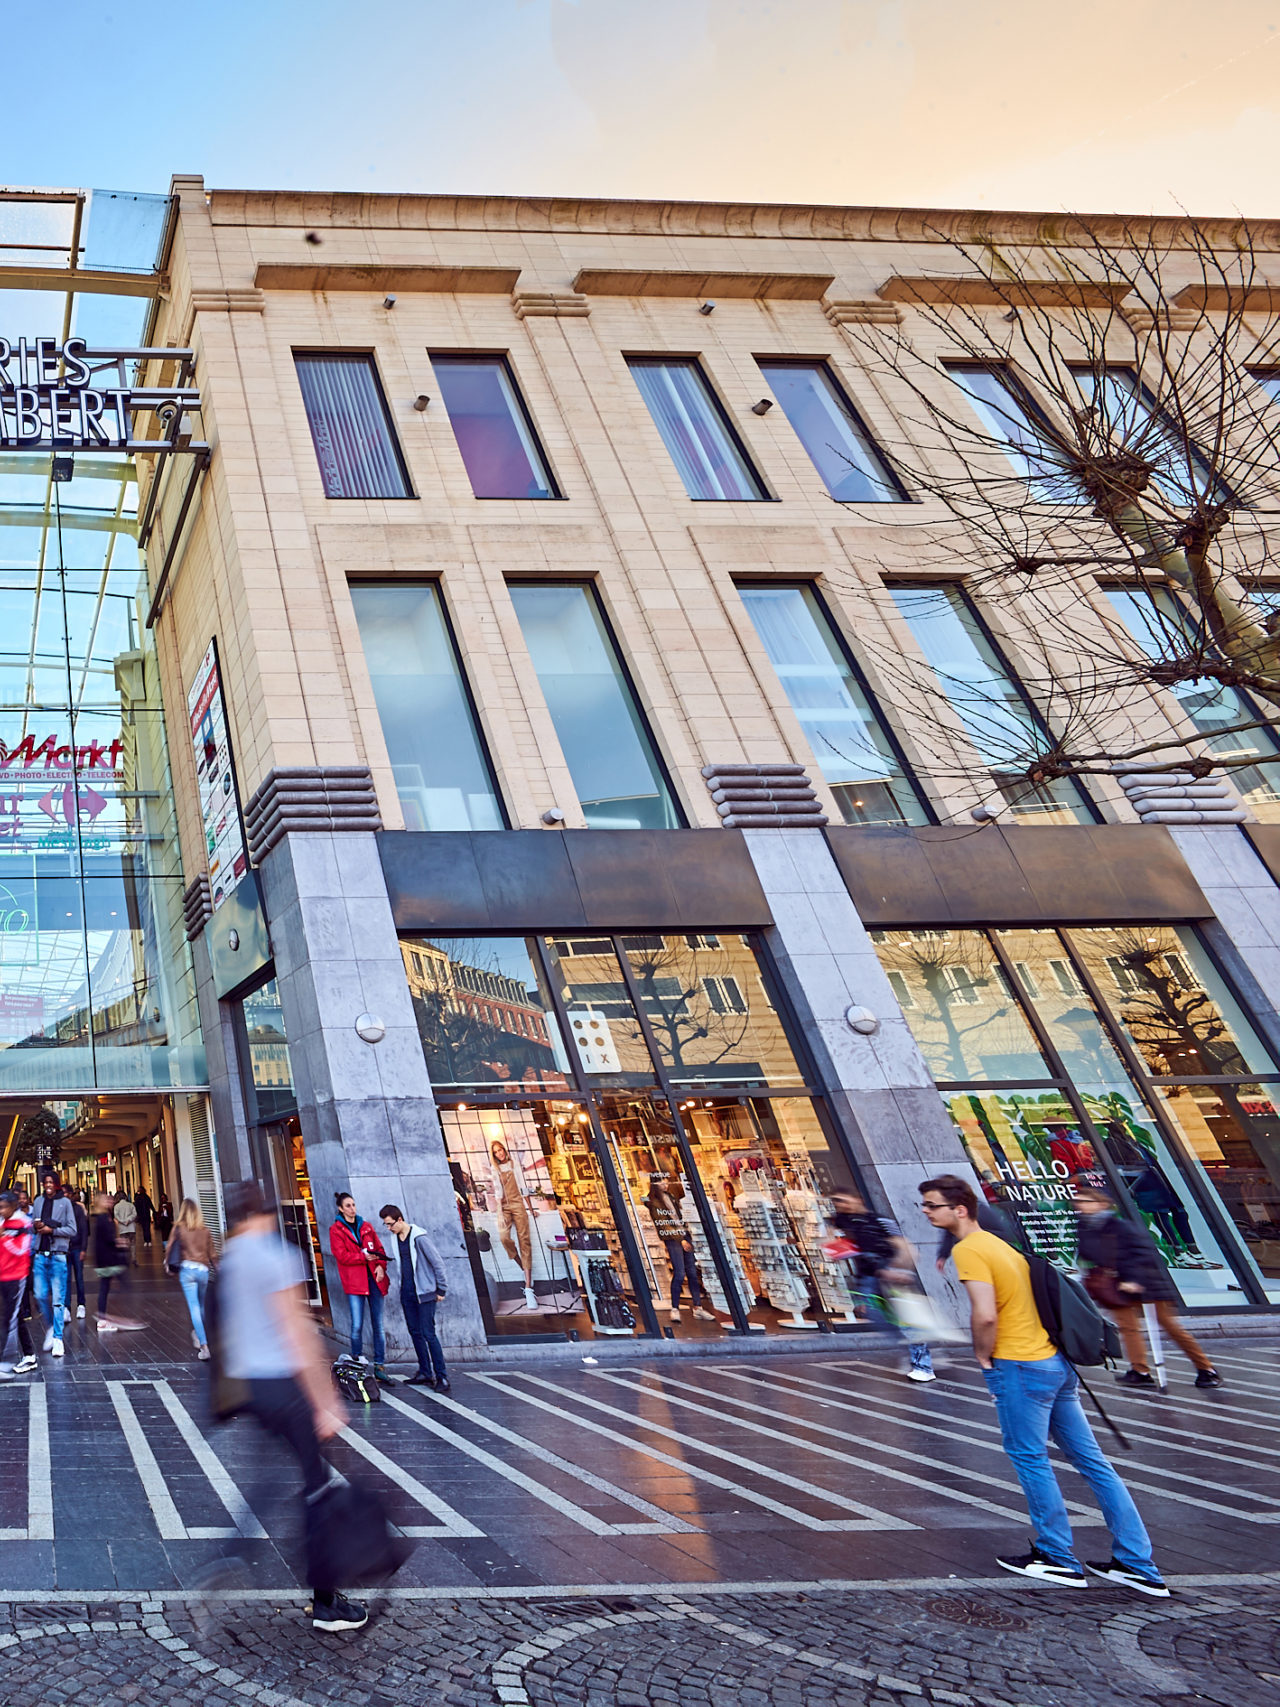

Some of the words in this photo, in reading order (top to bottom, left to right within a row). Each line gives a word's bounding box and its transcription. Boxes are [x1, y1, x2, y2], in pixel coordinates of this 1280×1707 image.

[0, 734, 124, 769] Markt
[88, 771, 124, 779] TELECOM
[995, 1160, 1069, 1180] HELLO
[1005, 1184, 1081, 1201] NATURE
